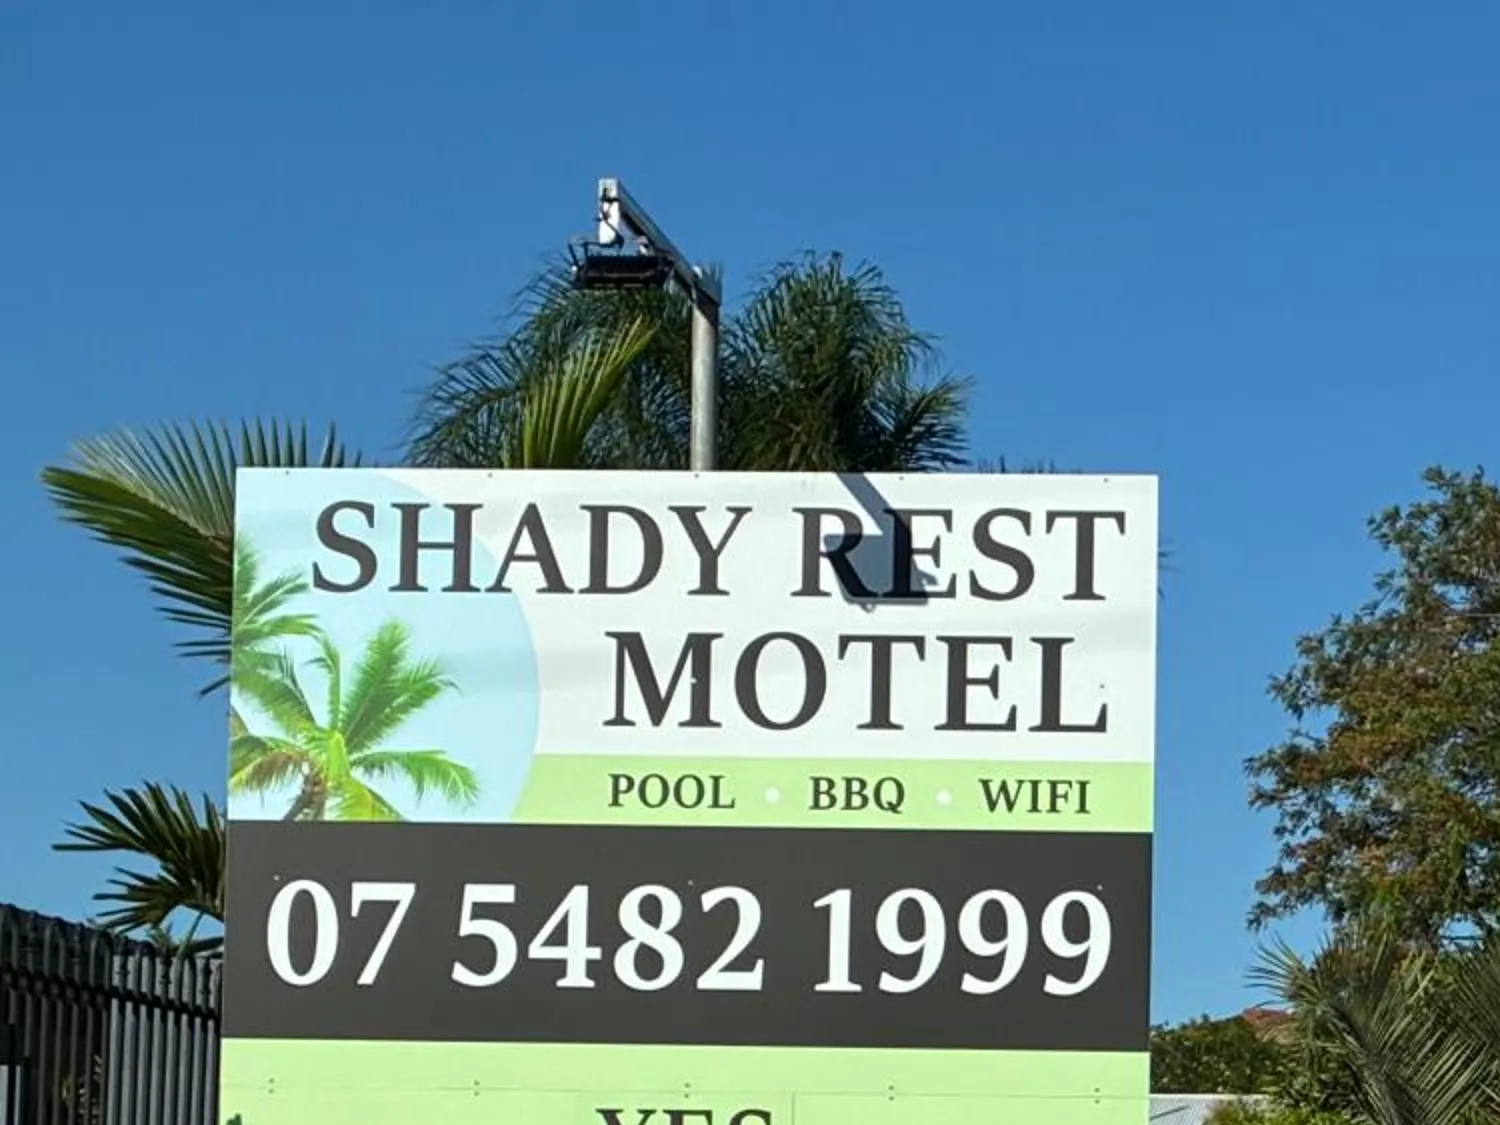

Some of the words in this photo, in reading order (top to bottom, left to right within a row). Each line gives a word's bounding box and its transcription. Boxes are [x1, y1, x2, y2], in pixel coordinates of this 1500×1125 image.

[313, 500, 753, 597] SHADY
[791, 506, 1127, 602] REST
[602, 630, 1109, 733] MOTEL
[608, 773, 737, 811] POOL
[808, 776, 906, 815] BBQ
[979, 779, 1092, 815] WIFI
[266, 878, 416, 988] 07
[450, 882, 765, 992] 5482
[811, 887, 1113, 996] 1999
